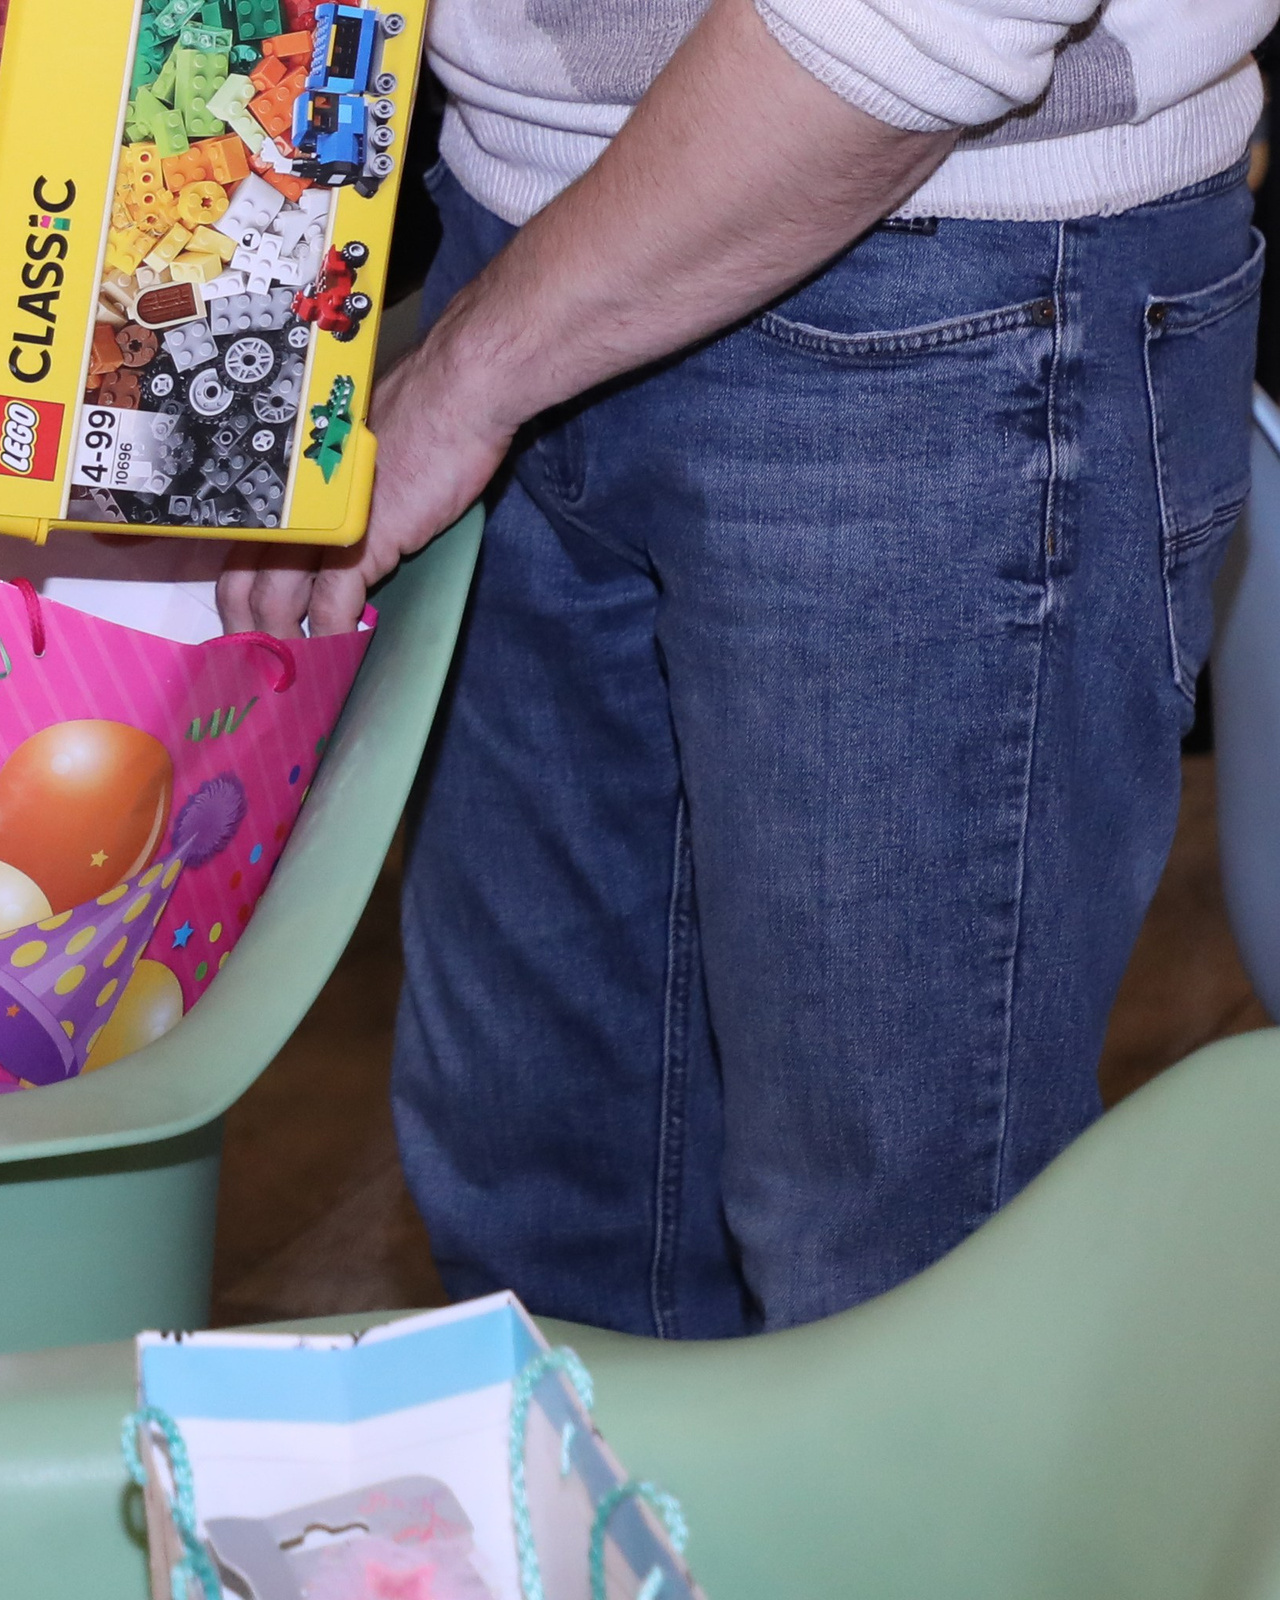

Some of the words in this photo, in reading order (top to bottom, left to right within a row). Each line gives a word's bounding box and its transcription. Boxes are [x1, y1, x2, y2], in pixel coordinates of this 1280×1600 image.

[0, 402, 37, 473] LEGO
[81, 410, 116, 483] 4-99
[115, 443, 133, 485] 10696
